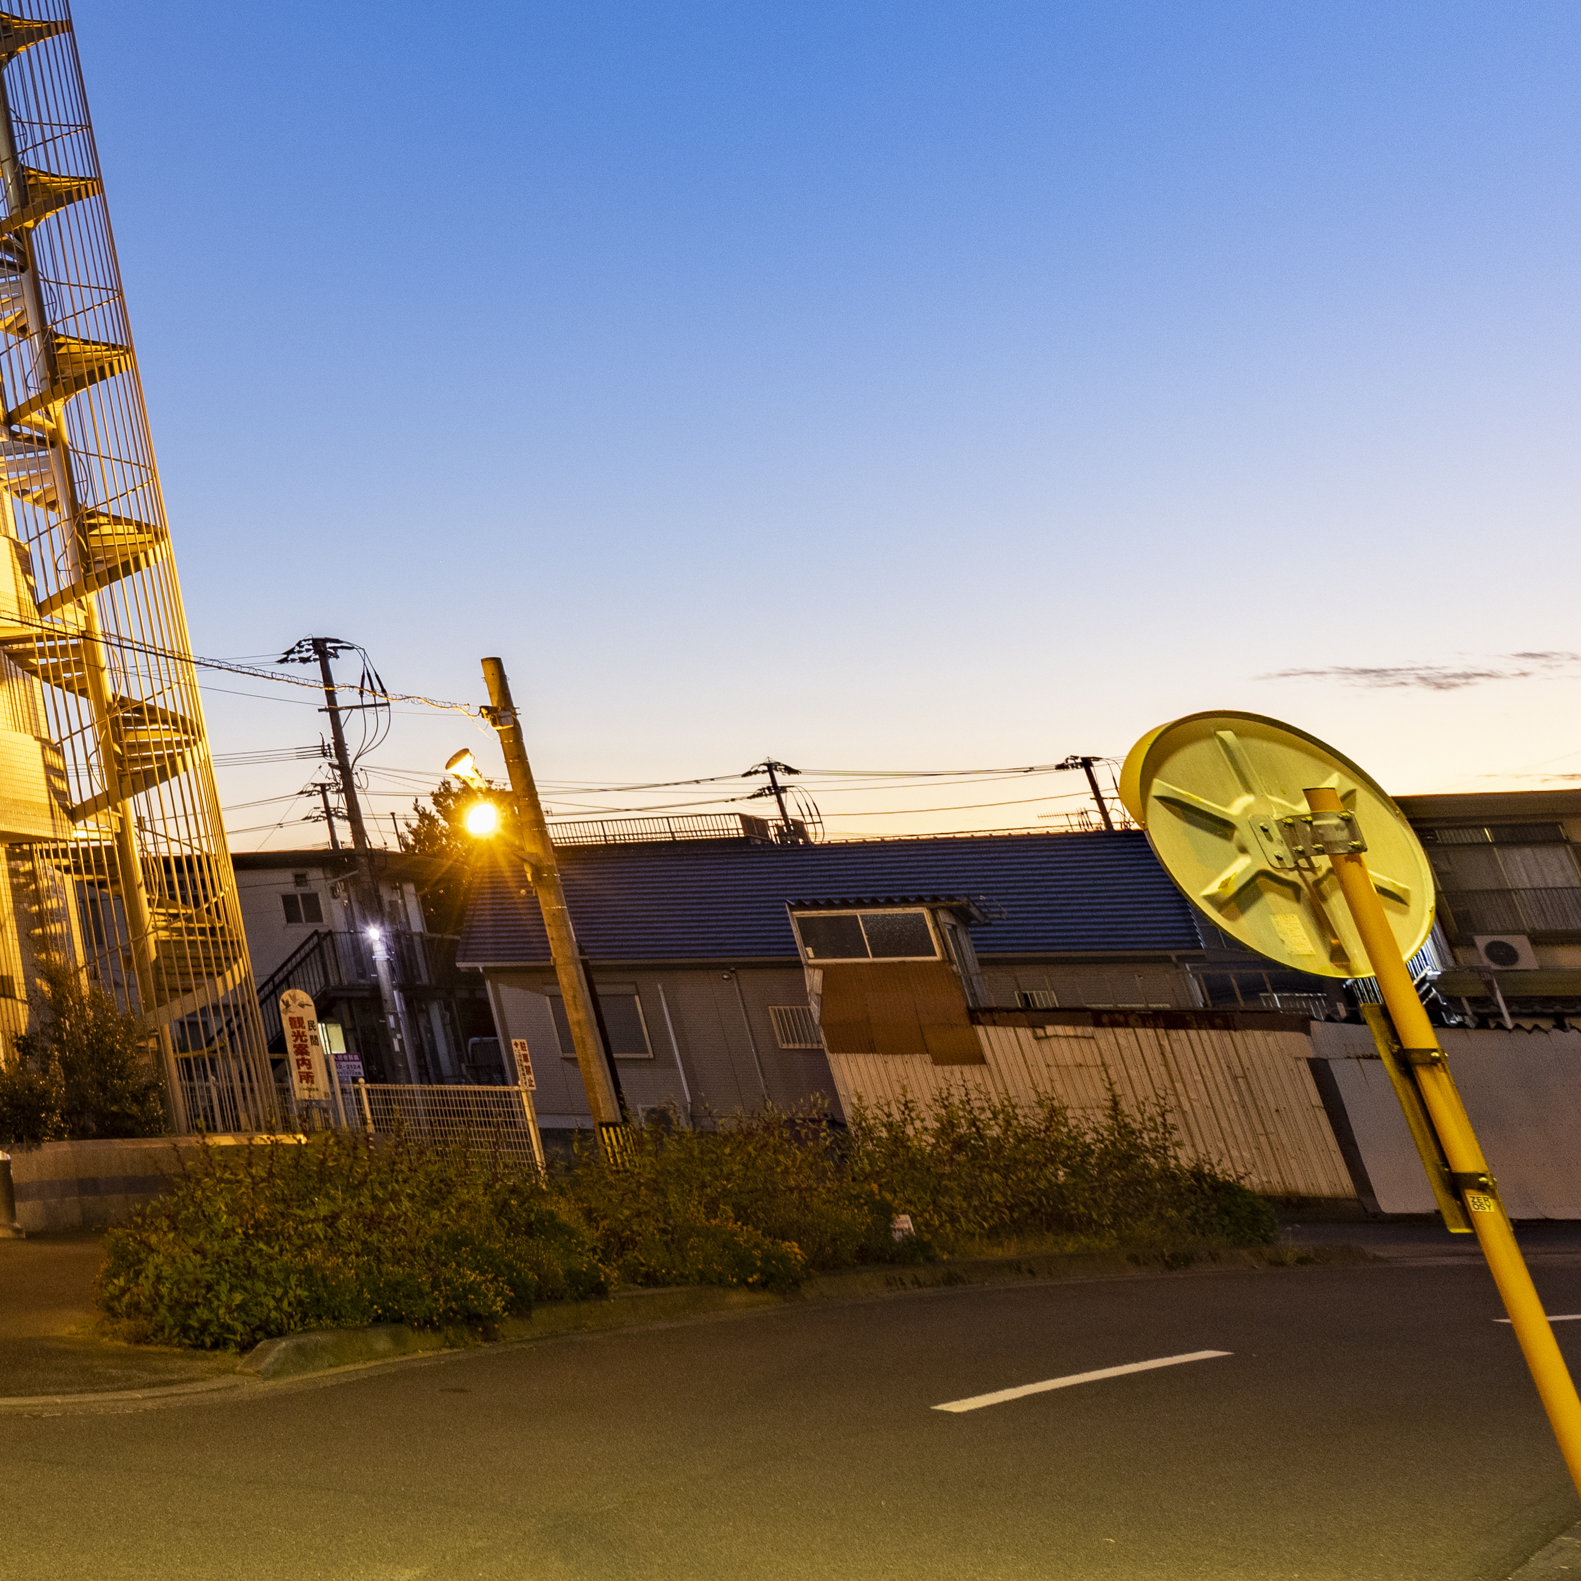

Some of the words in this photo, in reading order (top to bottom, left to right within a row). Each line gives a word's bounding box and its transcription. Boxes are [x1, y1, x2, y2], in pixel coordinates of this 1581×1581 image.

[288, 1016, 315, 1085] 観光案内所
[307, 1020, 320, 1047] 民間
